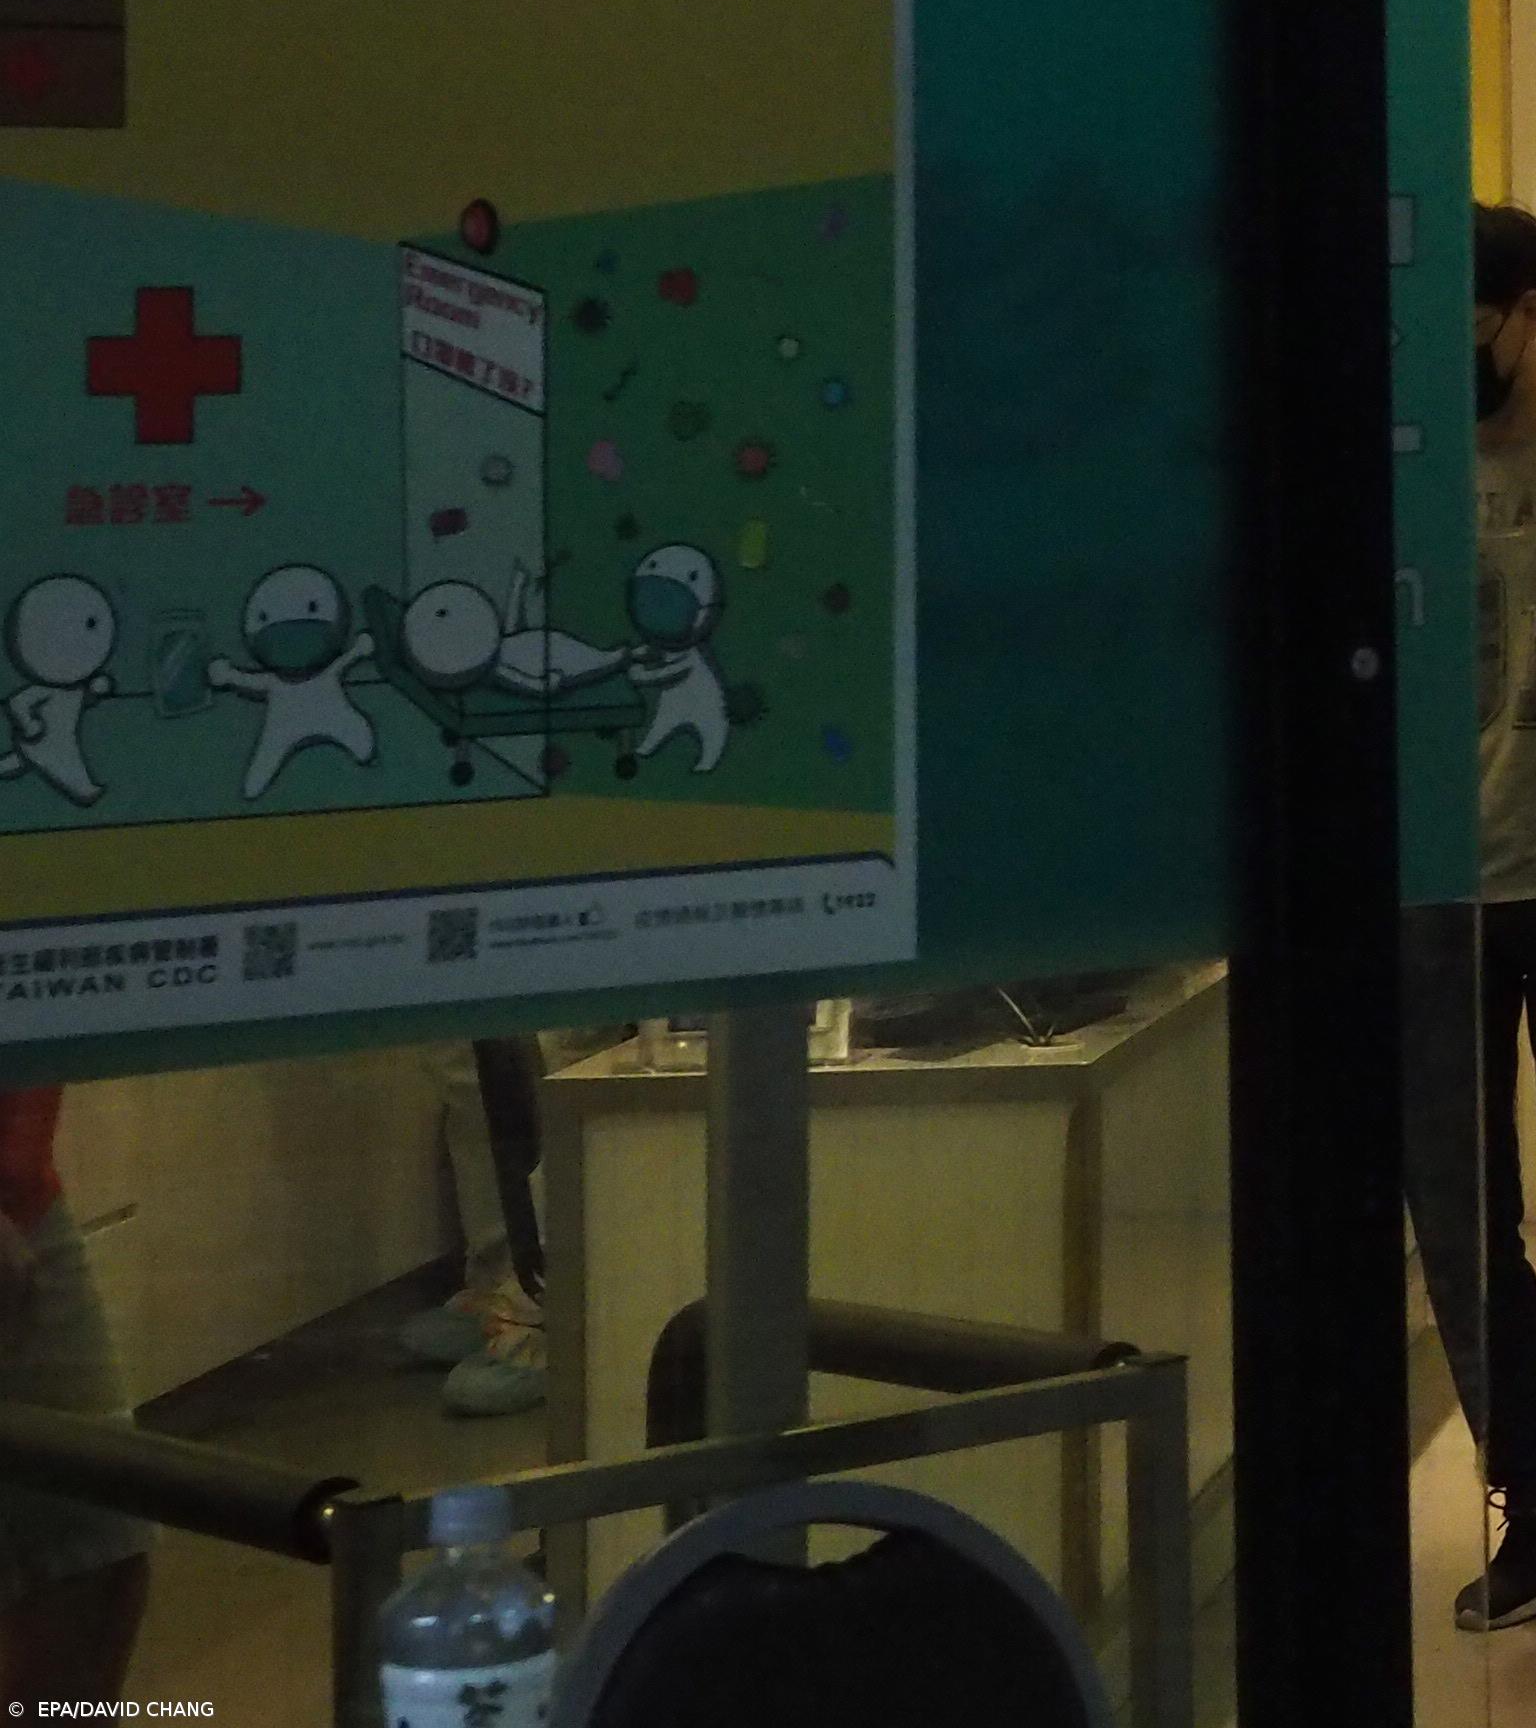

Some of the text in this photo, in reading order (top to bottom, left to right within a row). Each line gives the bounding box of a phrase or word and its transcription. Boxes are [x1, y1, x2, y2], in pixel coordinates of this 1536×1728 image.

[65, 483, 192, 525] 急診室
[0, 964, 217, 1000] AIWAN CDC
